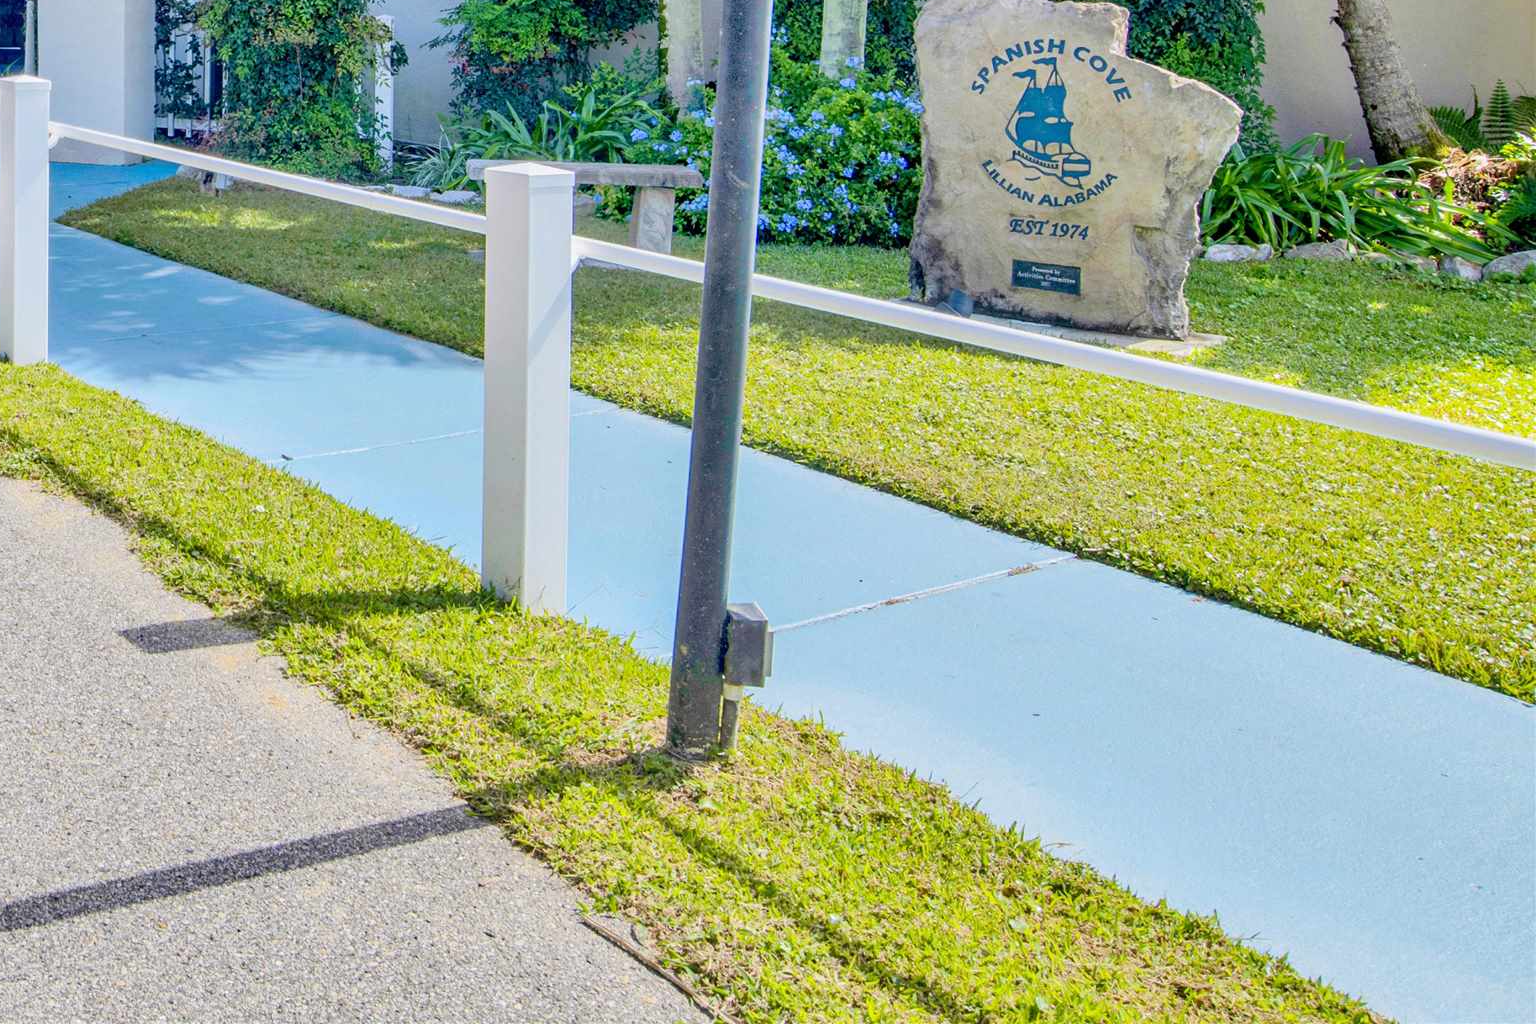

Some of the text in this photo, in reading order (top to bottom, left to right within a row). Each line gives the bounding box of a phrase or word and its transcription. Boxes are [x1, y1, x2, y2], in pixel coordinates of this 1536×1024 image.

[971, 38, 1132, 103] SPANISH COVE
[981, 159, 1119, 207] LILLIAN ALABAMA
[1009, 218, 1089, 240] EST 1974
